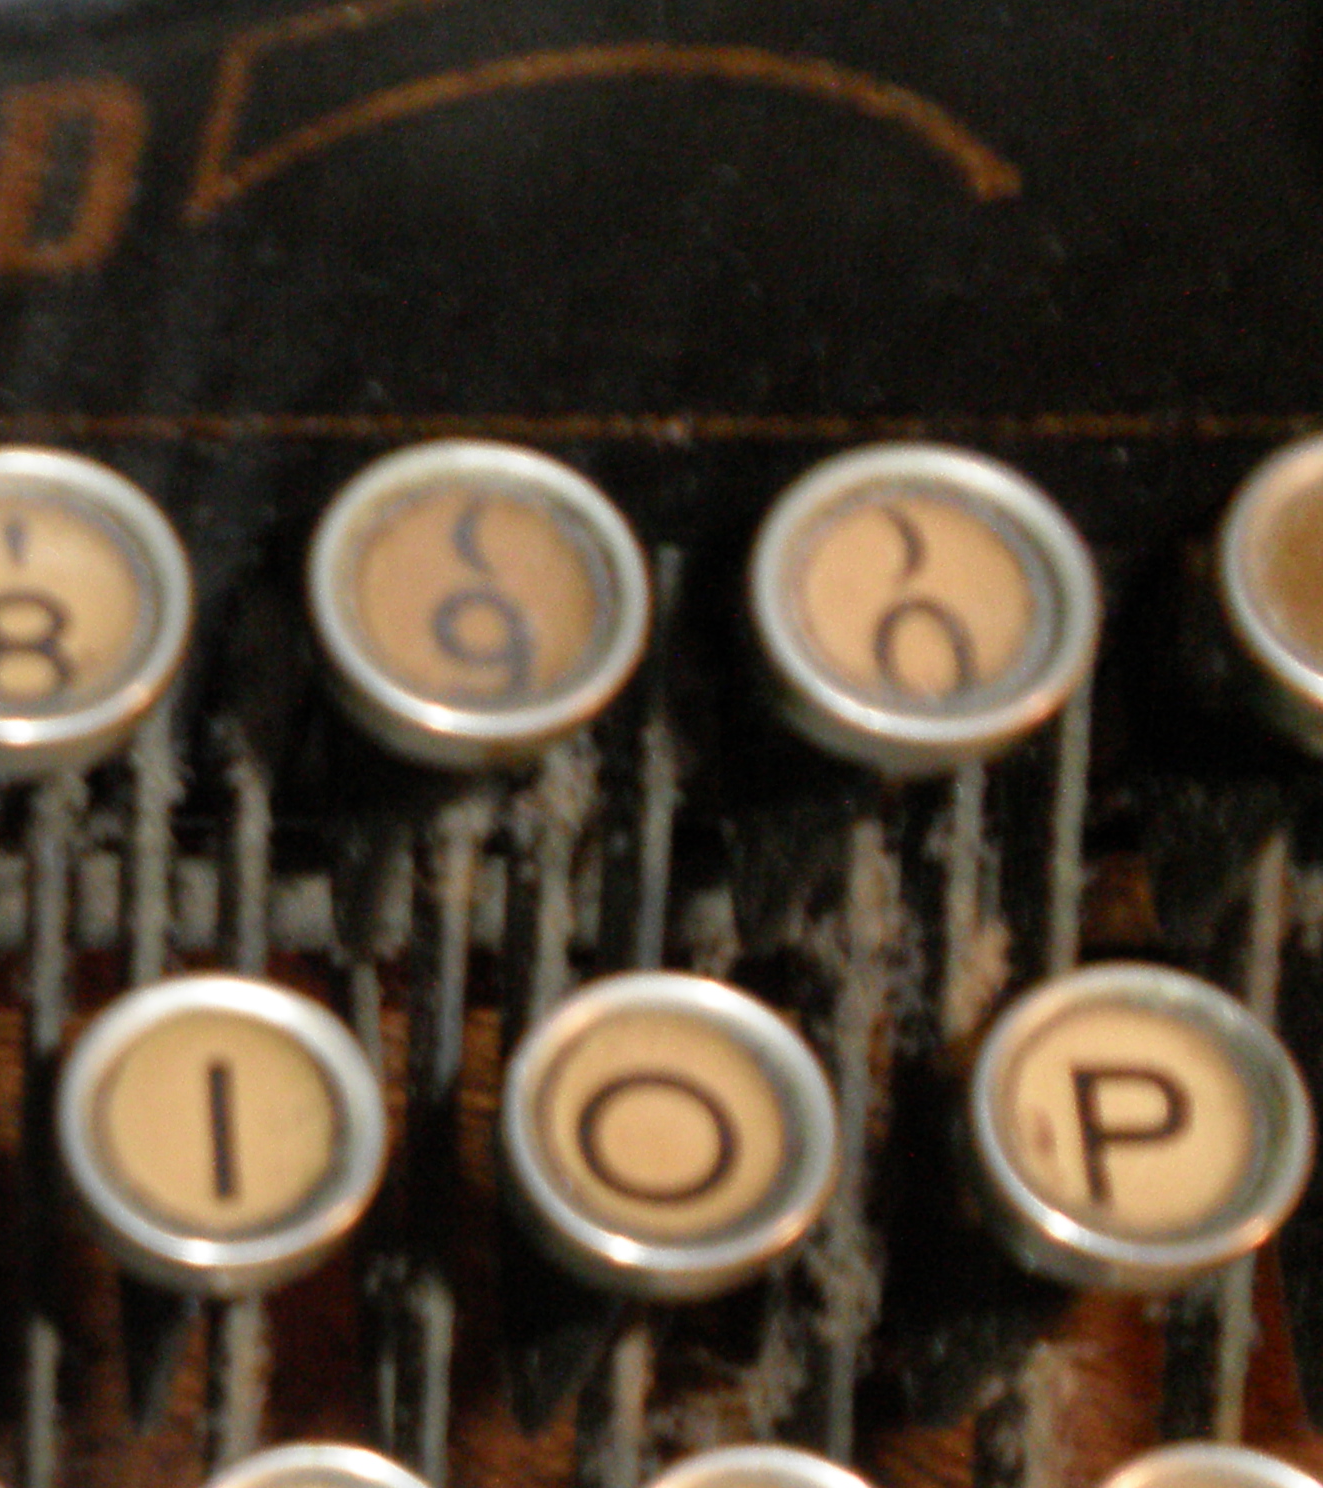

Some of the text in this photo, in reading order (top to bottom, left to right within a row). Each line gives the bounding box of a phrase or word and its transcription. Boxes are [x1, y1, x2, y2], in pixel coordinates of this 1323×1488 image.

[431, 590, 533, 700] 9
[206, 1058, 242, 1204] I
[577, 1069, 741, 1205] O
[1070, 1062, 1195, 1208] P
